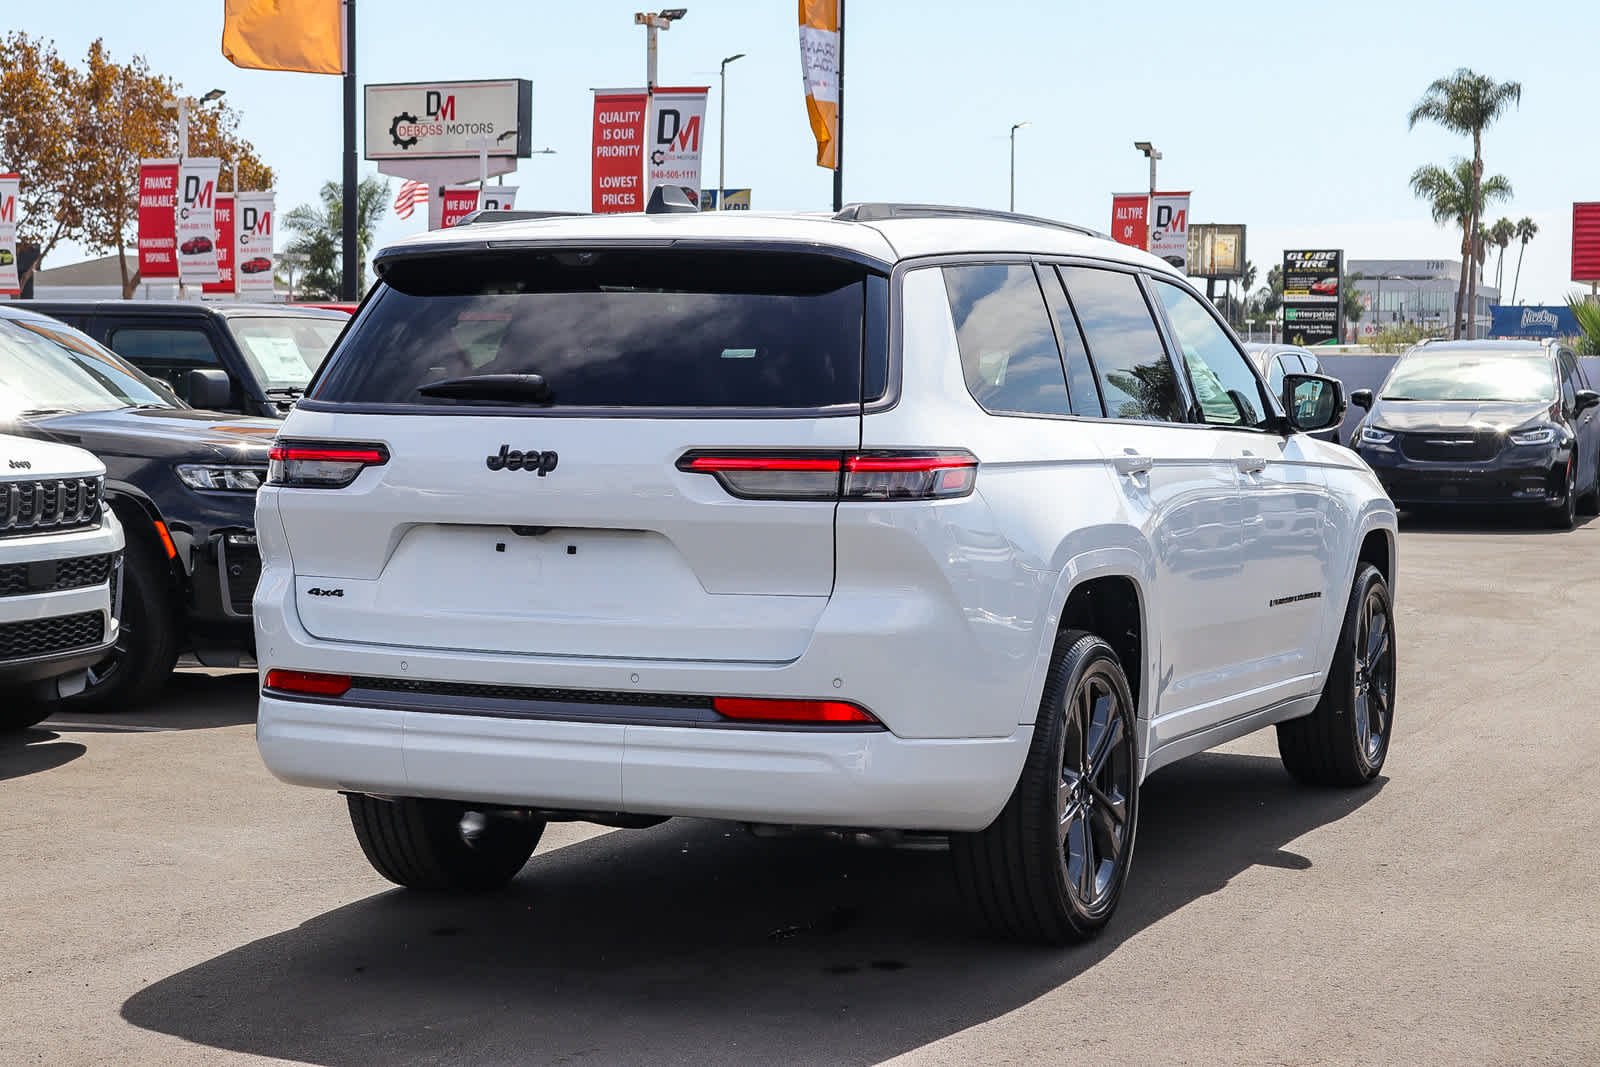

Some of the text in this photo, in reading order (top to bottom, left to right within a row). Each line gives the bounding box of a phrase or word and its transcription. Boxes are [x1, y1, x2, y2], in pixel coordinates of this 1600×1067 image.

[426, 91, 455, 121] DM
[599, 111, 641, 123] QUALITY
[400, 122, 494, 137] DEBOSS MOTORS
[603, 128, 635, 140] IS OUR
[657, 109, 701, 152] DM
[596, 145, 640, 157] PRIORITY
[144, 176, 172, 189] FINANCE
[600, 176, 637, 188] LOWEST
[184, 176, 214, 208] DM
[141, 195, 173, 207] AVAILABLE
[447, 200, 459, 210] WE
[460, 200, 475, 210] BUY
[602, 193, 635, 205] PRICES
[1117, 207, 1144, 219] ALL TYPE
[1157, 206, 1186, 232] DM
[243, 208, 271, 236] DM
[1124, 226, 1133, 238] OF
[487, 444, 558, 477] Jeep
[307, 588, 344, 597] 4x4
